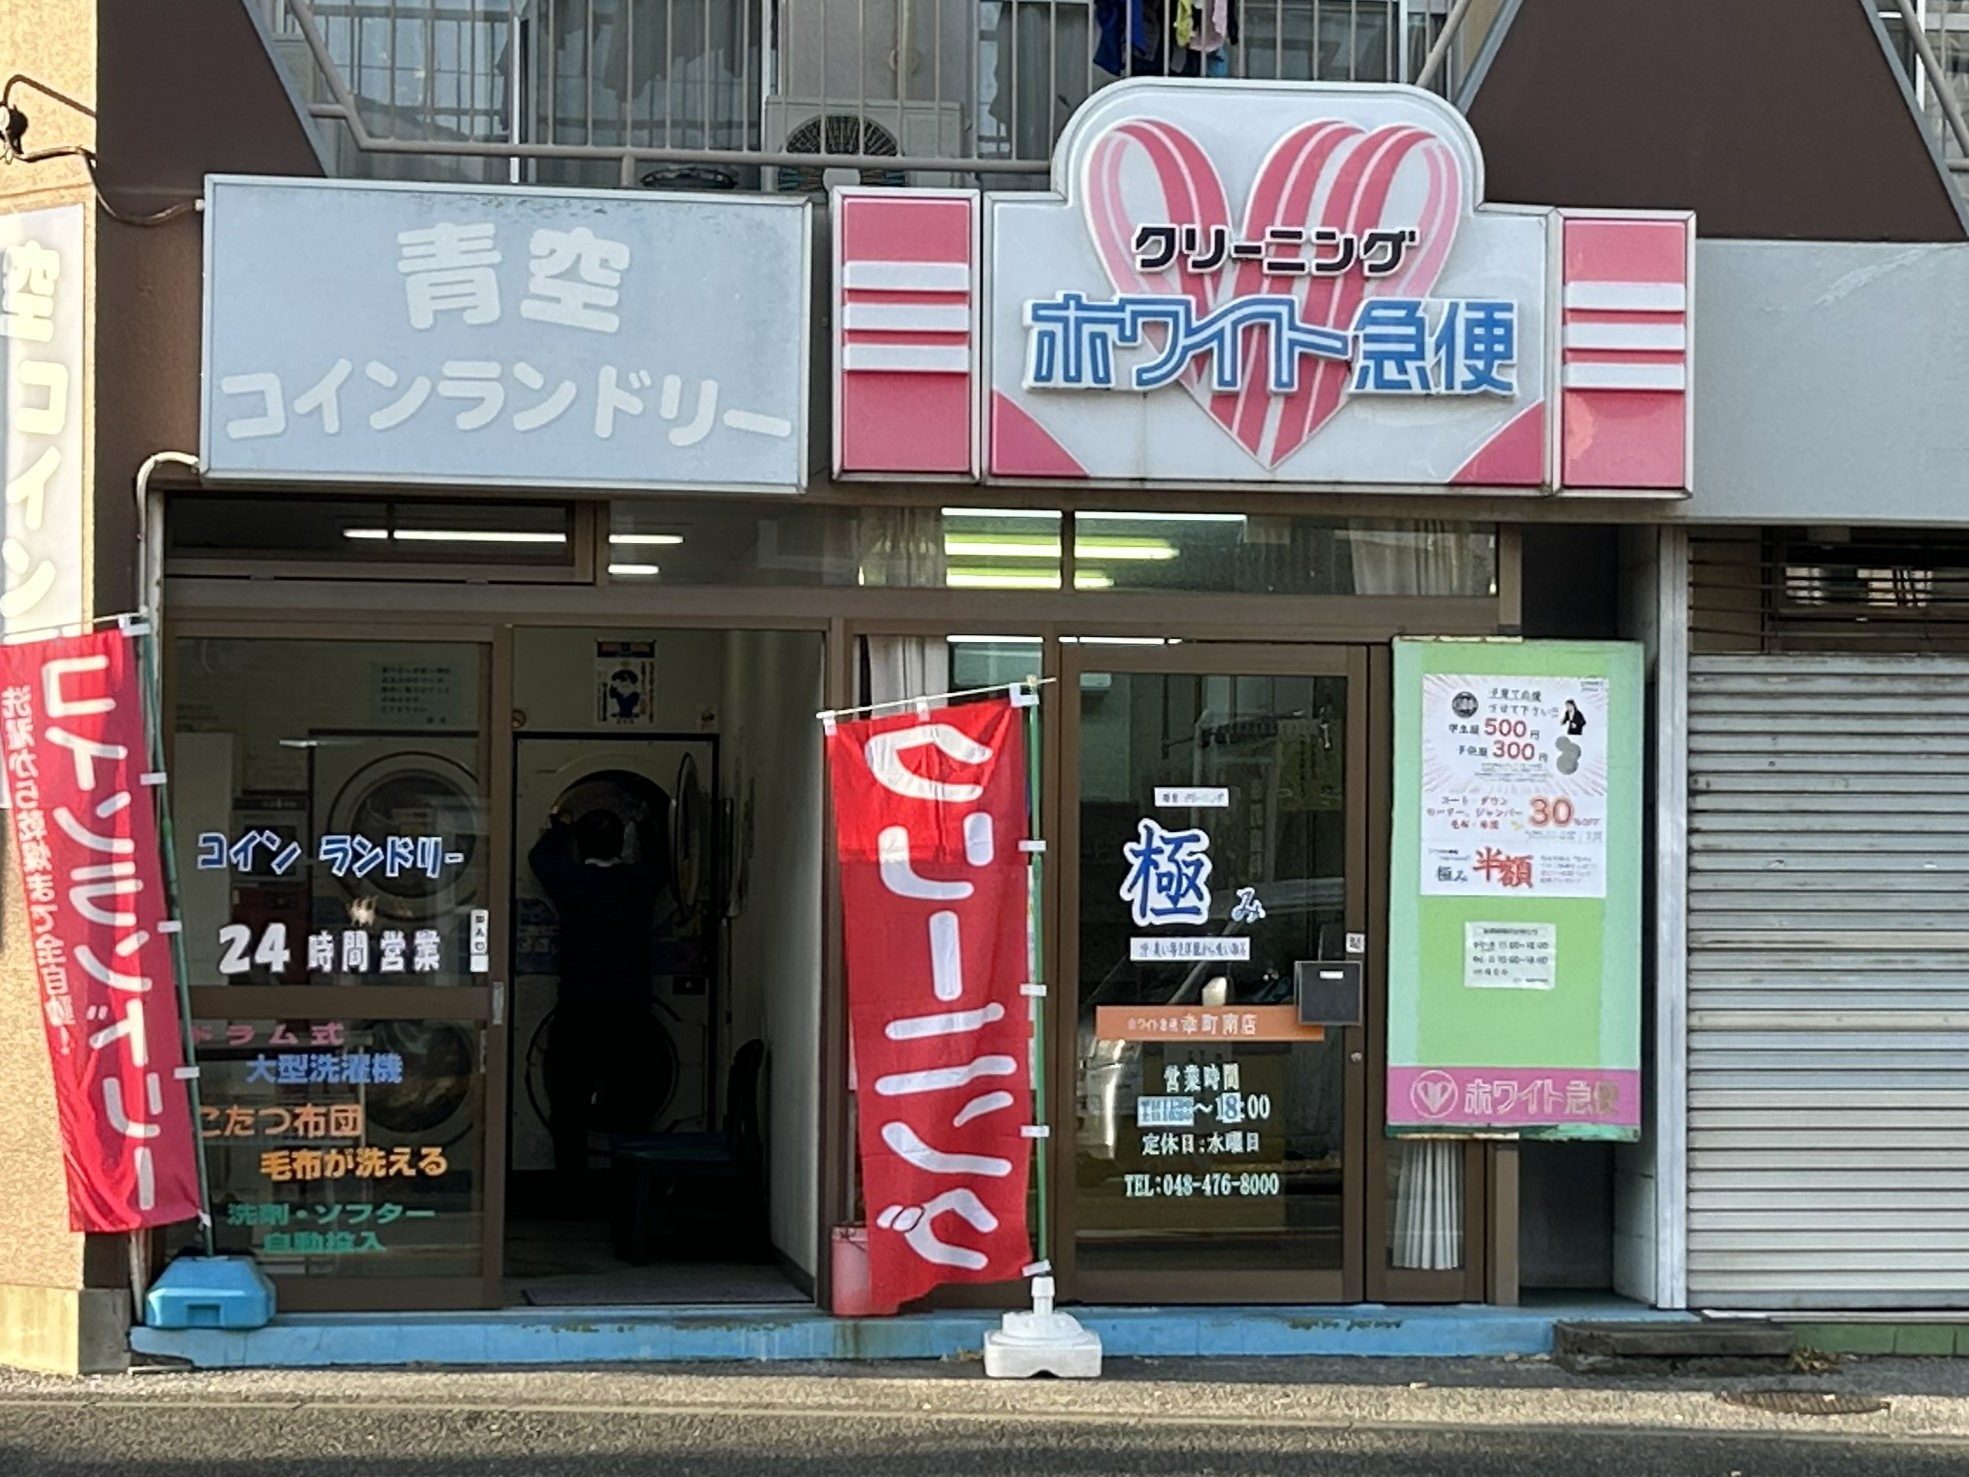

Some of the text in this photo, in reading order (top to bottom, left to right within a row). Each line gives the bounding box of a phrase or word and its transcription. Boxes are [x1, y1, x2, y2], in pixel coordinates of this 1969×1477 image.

[1133, 223, 1419, 277] クリーニング
[397, 222, 630, 334] 青空
[1025, 293, 1517, 395] ホワイト急便
[220, 358, 793, 447] コインランドリー
[197, 830, 465, 878] コイン ランドリー
[1472, 845, 1534, 889] 半額
[246, 1053, 404, 1085] 大型洗濯機
[1164, 1062, 1240, 1093] 営業時間
[260, 1146, 449, 1182] 毛布が洗える
[226, 1202, 436, 1227] 洗剤・ソフター
[263, 1230, 387, 1255] 自動投入
